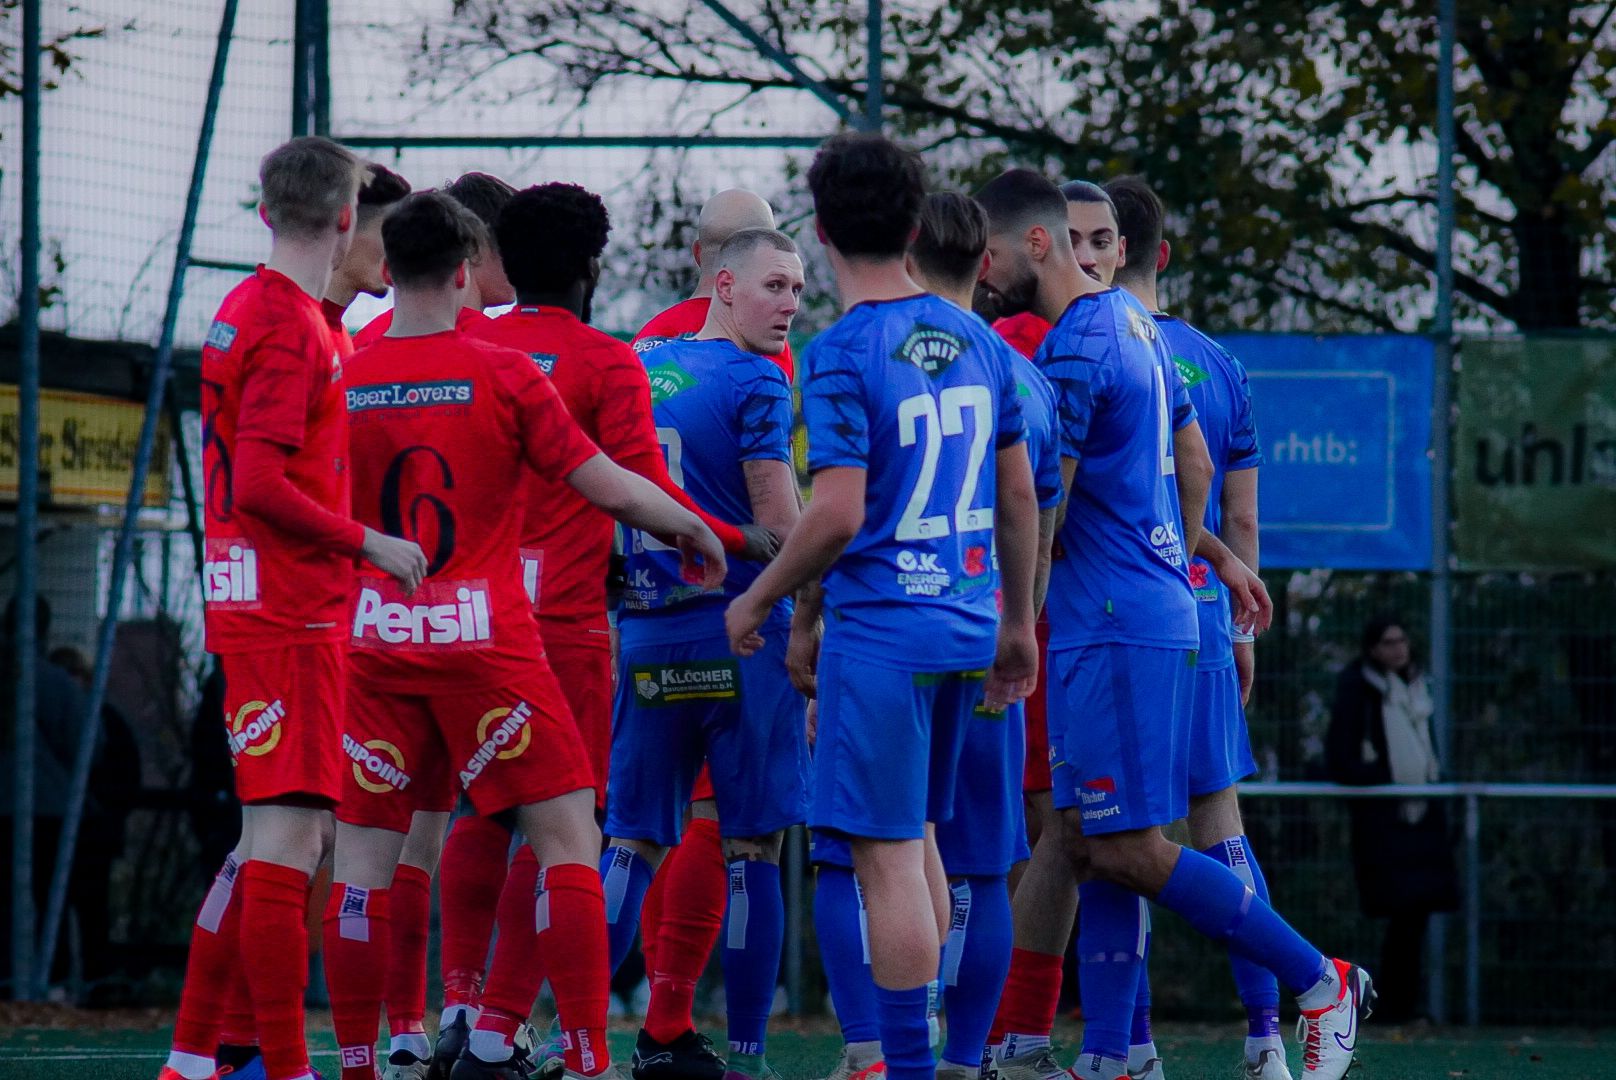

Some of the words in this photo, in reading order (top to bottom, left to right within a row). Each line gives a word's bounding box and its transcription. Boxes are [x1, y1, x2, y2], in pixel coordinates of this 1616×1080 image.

[346, 384, 471, 409] BeerLovers
[895, 384, 993, 541] 22
[1273, 431, 1358, 464] rhtb:
[381, 446, 455, 577] 6
[627, 568, 656, 588] .K.
[352, 588, 490, 644] Persil
[458, 701, 533, 790] ASHPOINT
[344, 1047, 369, 1068] FS
